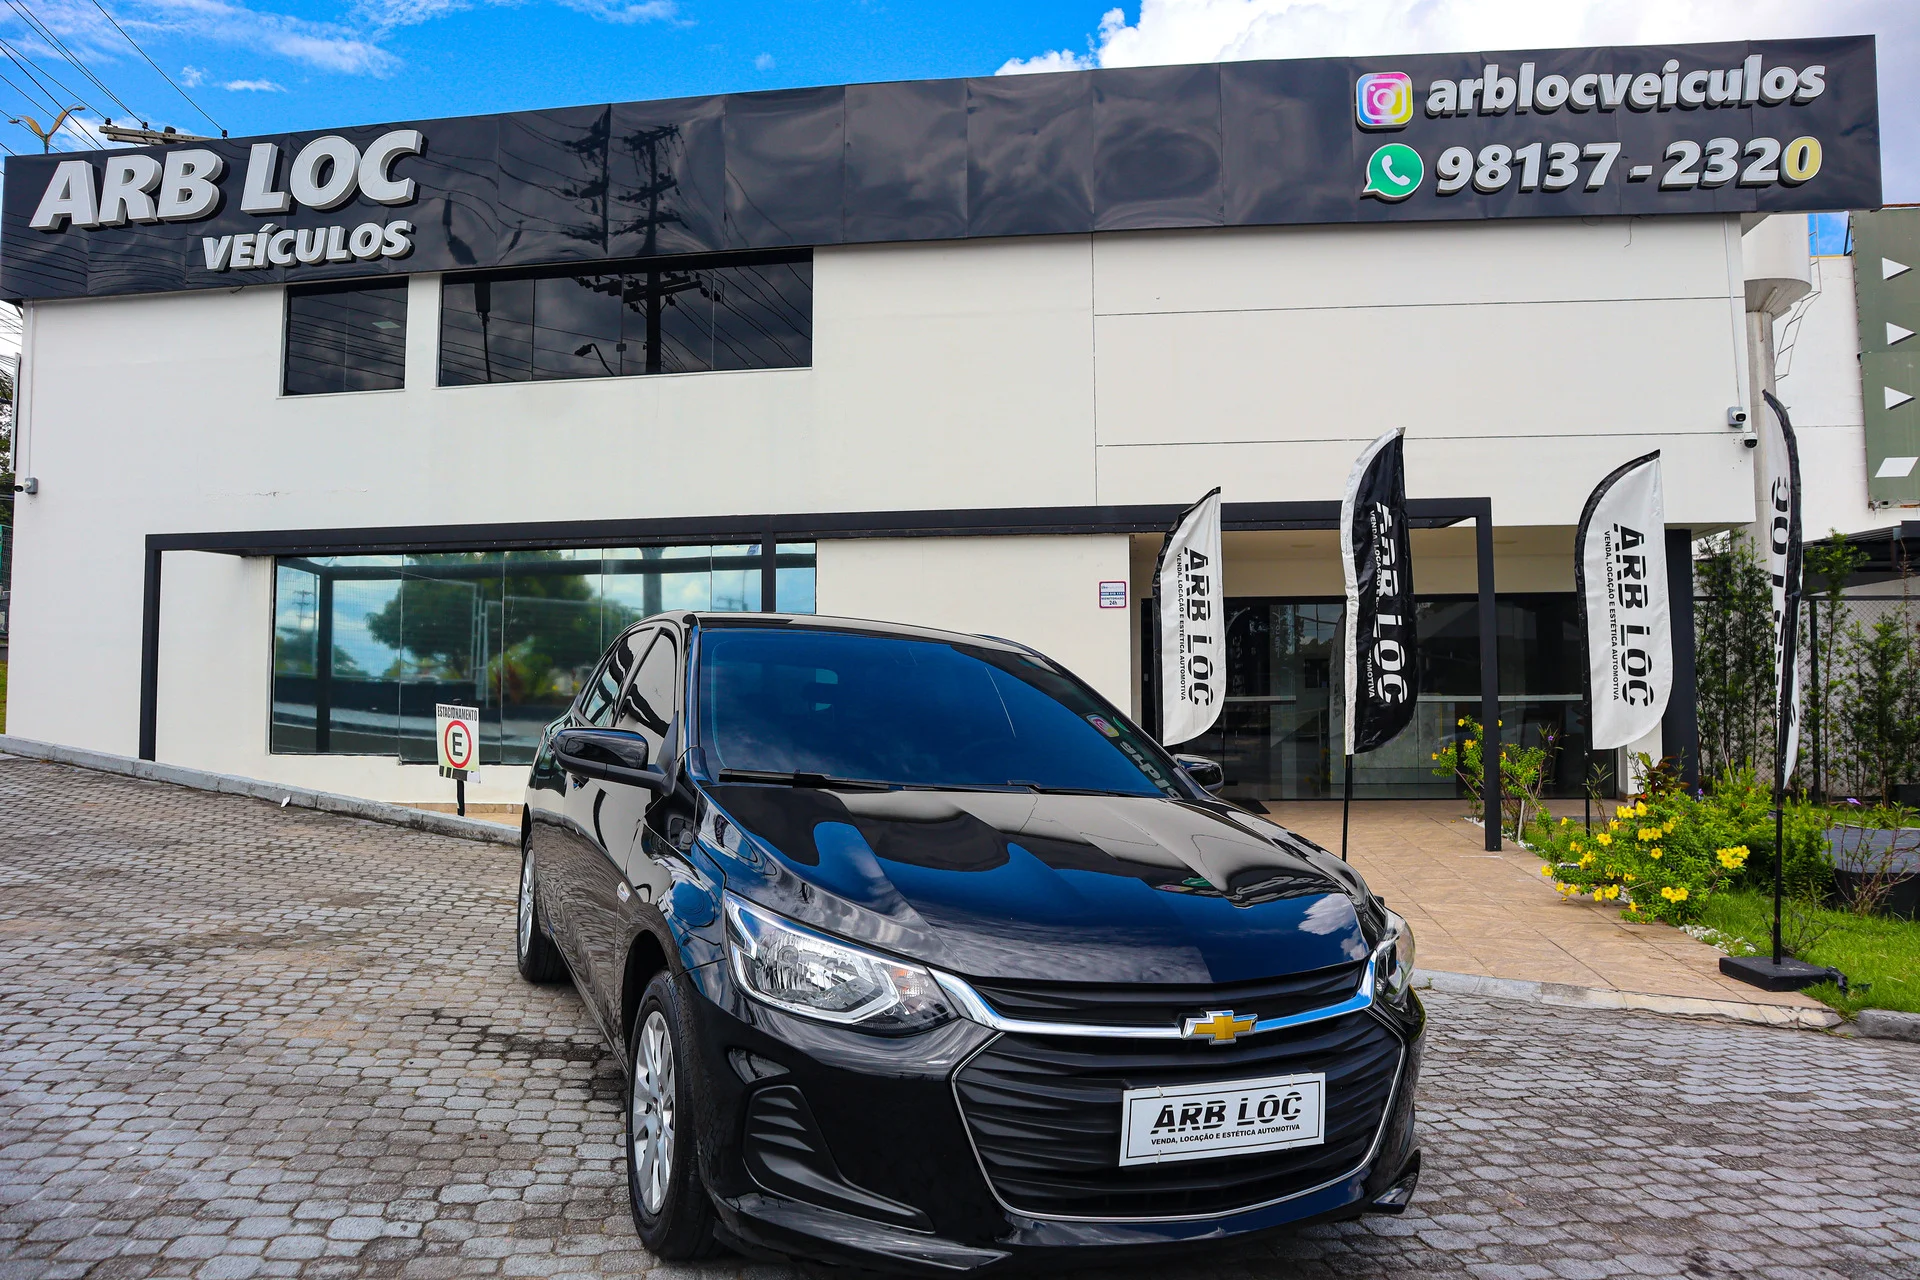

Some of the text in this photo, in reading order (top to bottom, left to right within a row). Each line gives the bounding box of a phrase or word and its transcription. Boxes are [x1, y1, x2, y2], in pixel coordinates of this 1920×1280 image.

[1426, 54, 1826, 115] arblocveiculos
[29, 129, 424, 231] ARB LOC
[202, 220, 415, 271] VEÍCULOS
[1606, 562, 1615, 599] LOCAÇÃO
[1184, 547, 1214, 706] ARB LOC
[1610, 608, 1618, 647] ESTÉTICA
[1613, 523, 1654, 706] ARB LOC
[1373, 613, 1408, 703] LOC
[438, 706, 478, 722] ESTACIONAMENTO
[452, 732, 462, 756] E
[1150, 1092, 1302, 1134] ARB LOC
[1151, 1137, 1178, 1145] VENDA,
[1180, 1132, 1214, 1142] LOCAÇÃO
[1222, 1128, 1256, 1138] ESTÉTICA
[1257, 1124, 1300, 1134] AUTOMOTIVA
